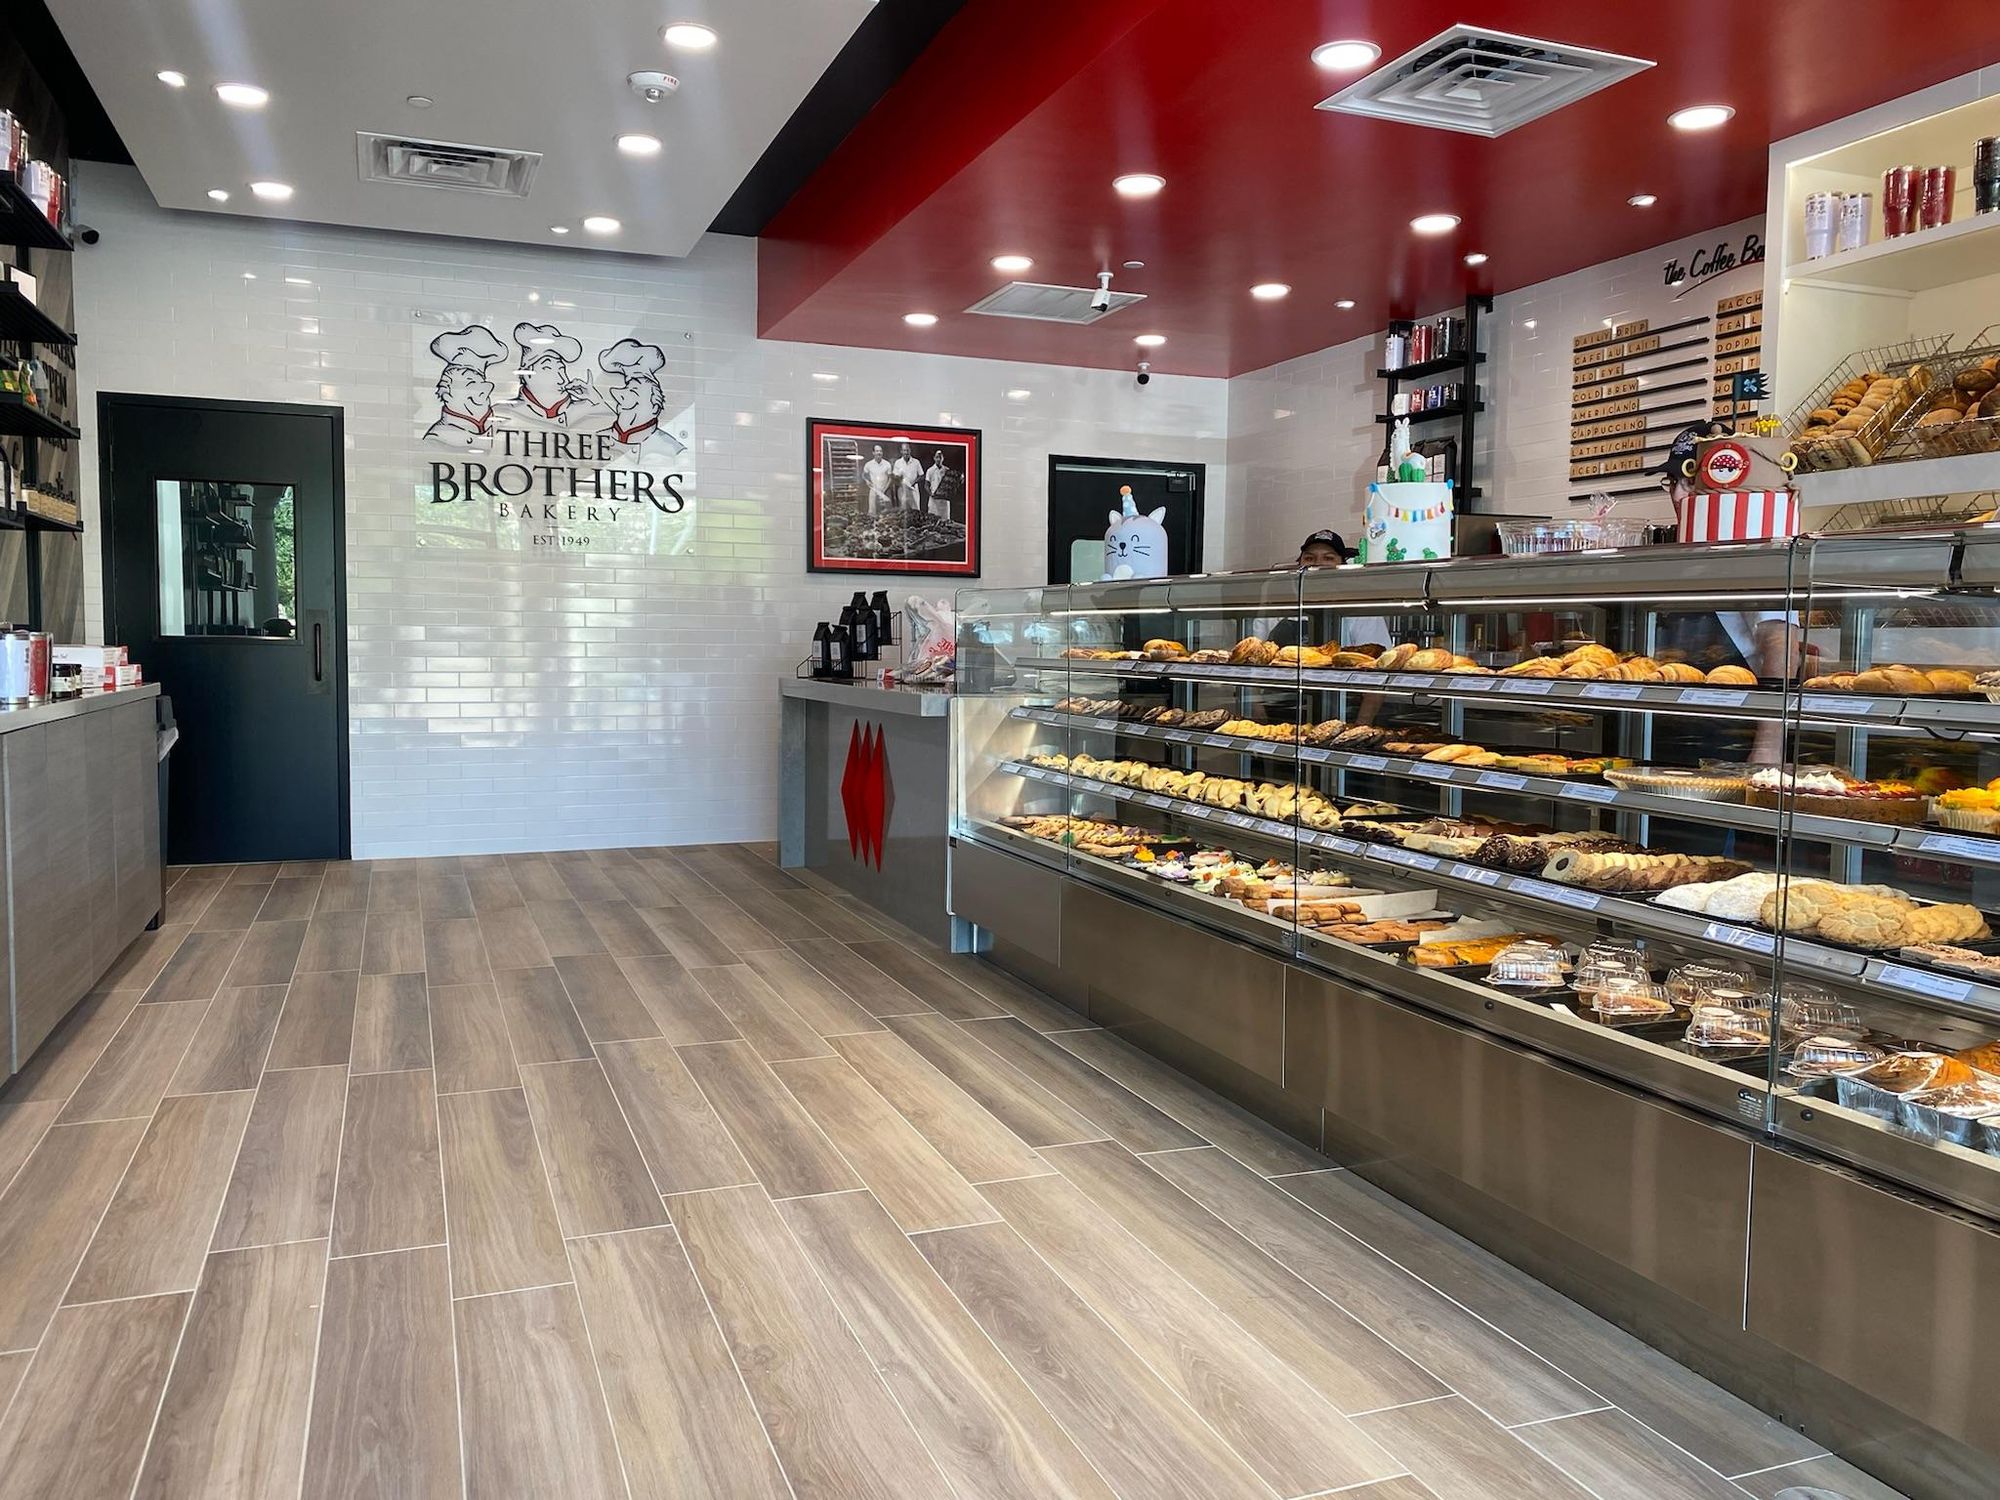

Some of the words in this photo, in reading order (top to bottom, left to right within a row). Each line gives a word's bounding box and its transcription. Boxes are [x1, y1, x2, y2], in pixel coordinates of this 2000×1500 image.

[1663, 259, 1686, 285] the
[1690, 242, 1736, 278] Coffee
[1574, 332, 1610, 346] DAILY
[1616, 323, 1646, 336] DRIP
[1718, 320, 1741, 332] TEA
[1574, 352, 1601, 366] CAFE
[1608, 348, 1621, 358] AU
[1628, 340, 1656, 353] LAIT
[1574, 372, 1594, 384] RED
[1600, 366, 1622, 378] EYE
[1716, 362, 1740, 374] HOT
[1573, 390, 1600, 402] COLD
[1607, 383, 1637, 395] BREW
[1572, 402, 1637, 420] AMERICANO
[1715, 402, 1747, 414] SOA
[1572, 420, 1644, 440] CAPPUCCINO
[496, 429, 613, 461] THREE
[1572, 440, 1642, 457] LATTE/CHAI
[1572, 465, 1598, 476] ICED
[1605, 459, 1640, 472] LATTE
[429, 462, 685, 514] BROTHERS
[499, 502, 621, 522] BAKERY
[562, 536, 590, 546] 1949
